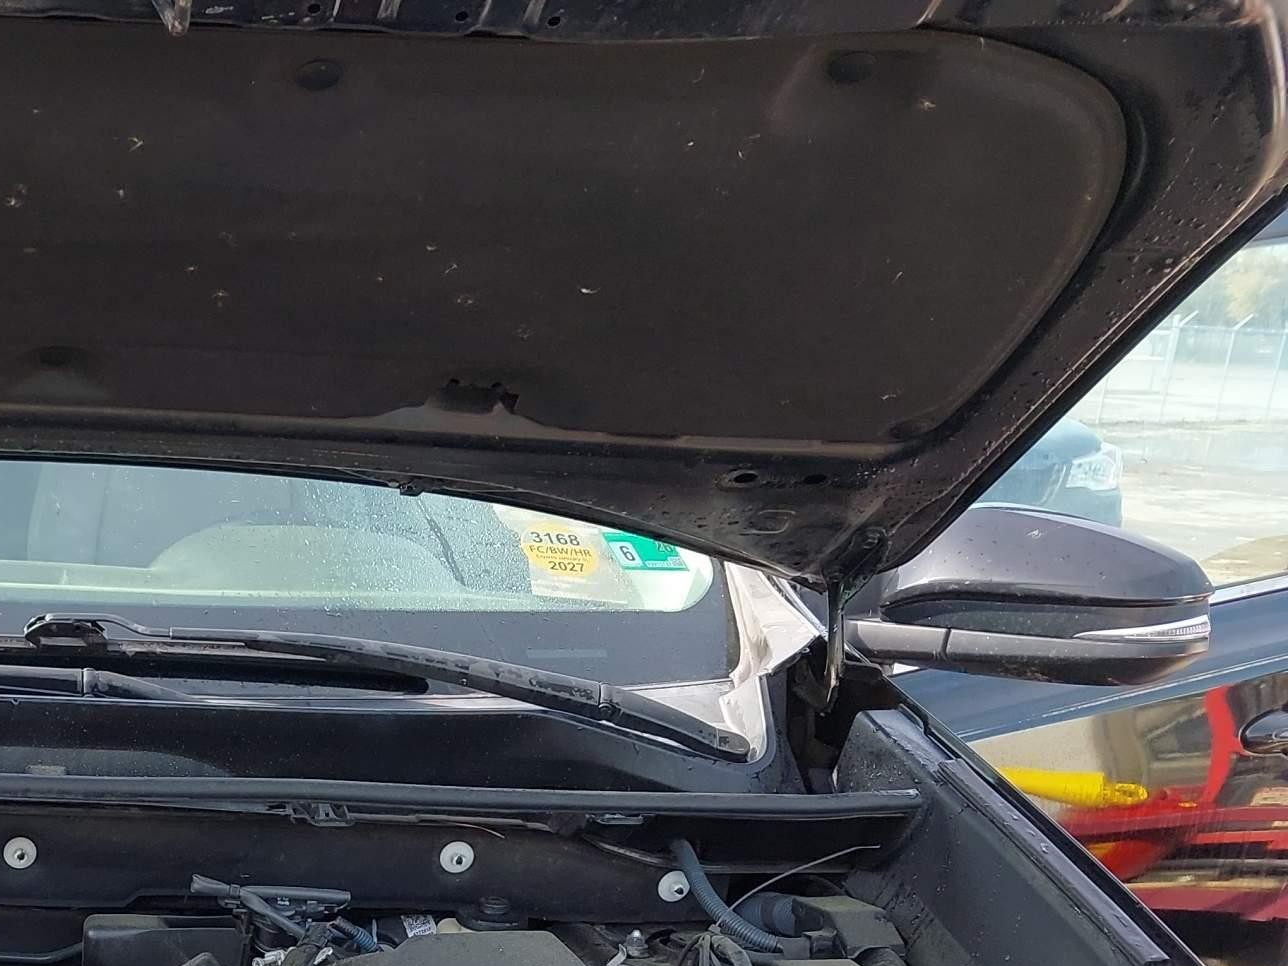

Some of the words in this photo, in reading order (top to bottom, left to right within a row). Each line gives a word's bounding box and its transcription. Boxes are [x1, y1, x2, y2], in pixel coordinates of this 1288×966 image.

[530, 531, 580, 546] 3168
[528, 545, 592, 558] FC/BW/HR
[619, 545, 636, 562] 6
[548, 560, 585, 573] 2027
